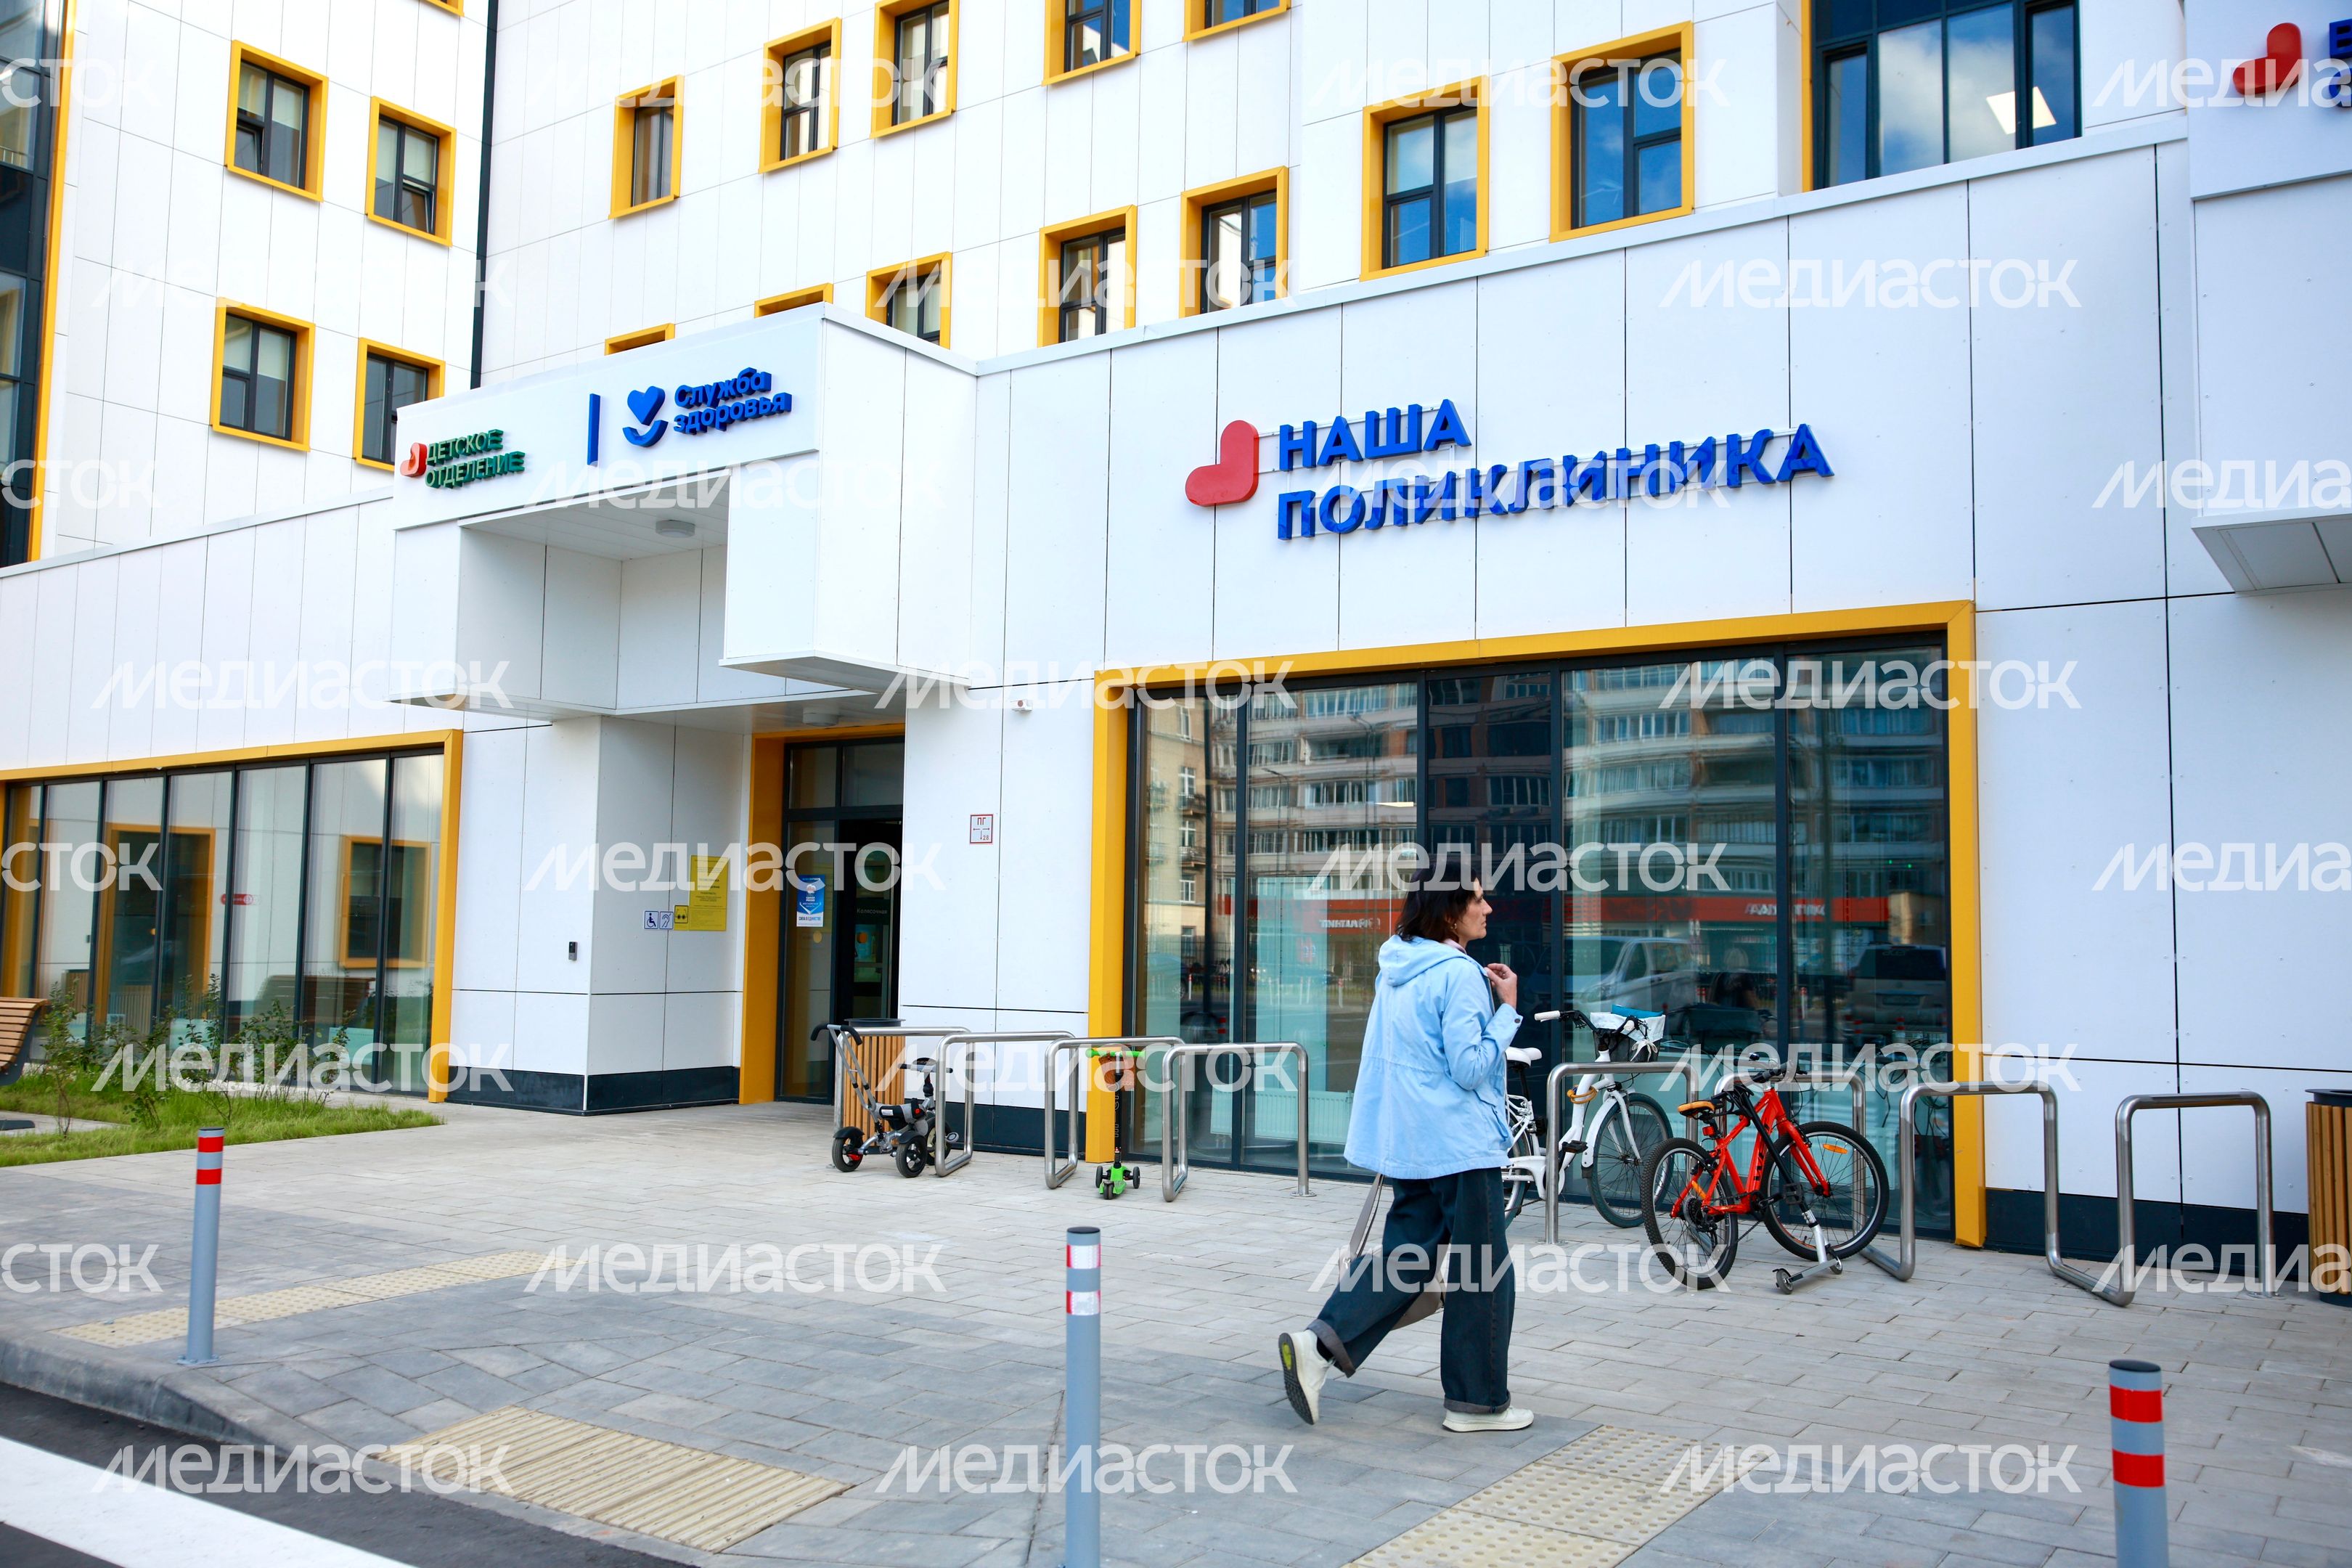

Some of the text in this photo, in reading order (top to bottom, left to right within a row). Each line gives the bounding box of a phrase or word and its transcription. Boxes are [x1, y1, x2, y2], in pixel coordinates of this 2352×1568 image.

[674, 367, 772, 409] Служба
[674, 392, 792, 435] здоровья
[427, 429, 504, 466] ДЕТСКОЕ
[1279, 399, 1472, 472] НАША
[425, 451, 526, 489] ОТДЕЛЕНИЕ
[1278, 424, 1834, 540] ПОЛИКЛИНИКА
[977, 817, 987, 825] ПГ
